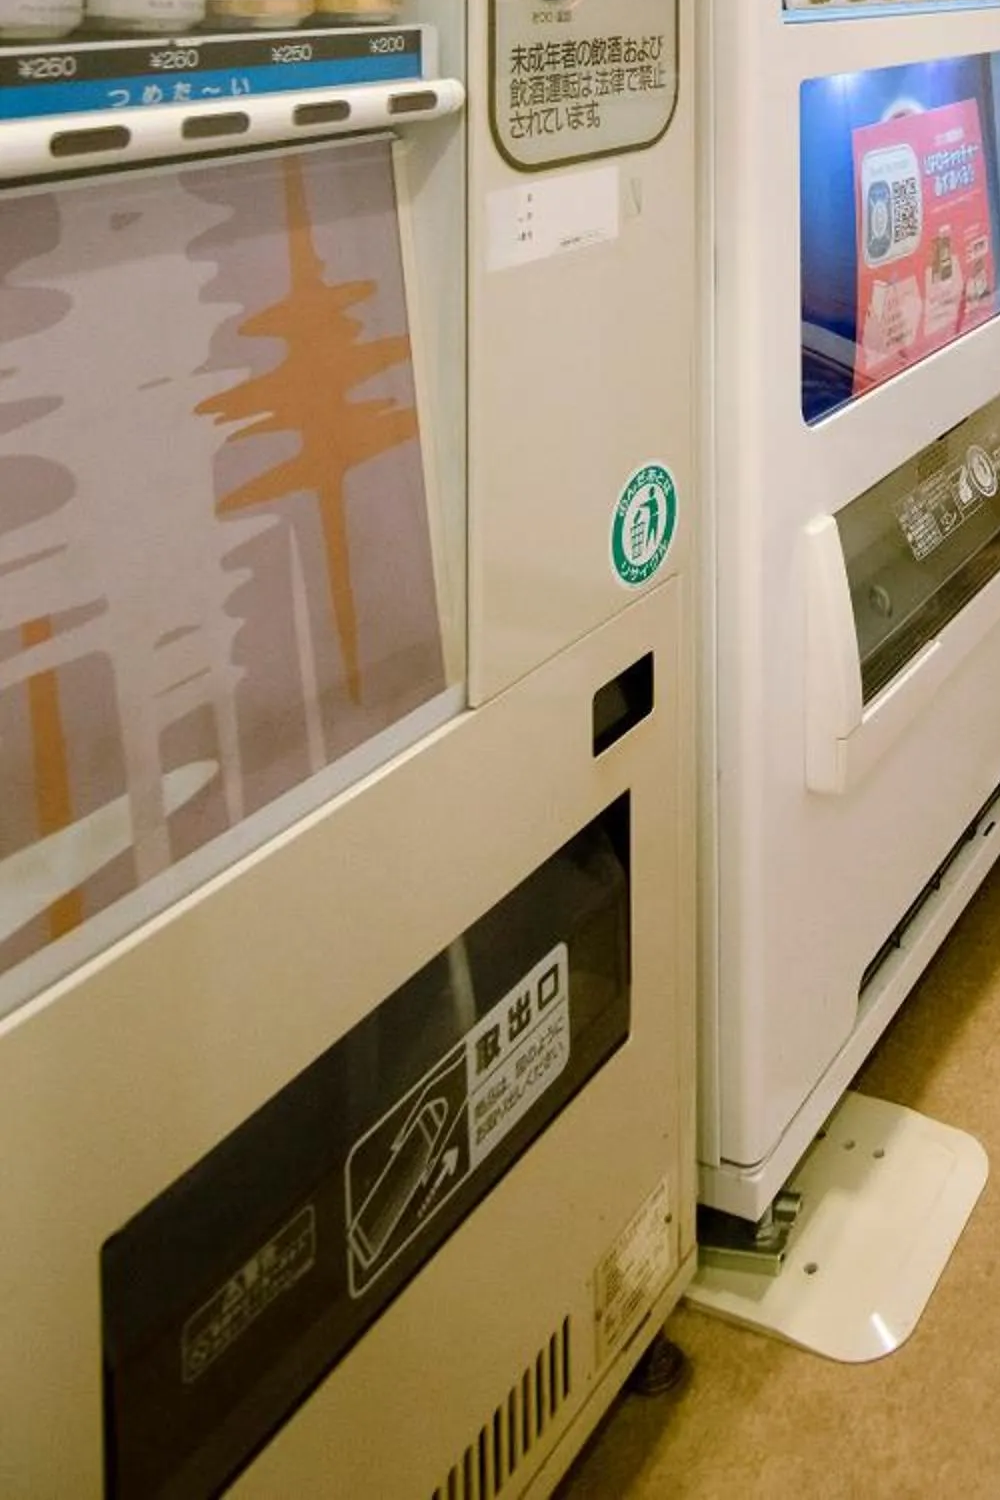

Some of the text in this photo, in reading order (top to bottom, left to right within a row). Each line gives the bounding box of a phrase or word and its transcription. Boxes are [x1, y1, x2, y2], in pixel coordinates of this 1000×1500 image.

[271, 43, 313, 64] ¥250
[369, 35, 405, 54] ¥200
[510, 34, 664, 75] 未成年者の飲酒および
[18, 55, 77, 79] ¥260
[150, 49, 200, 73] ¥260
[510, 61, 667, 109] 飲酒運転は法律で禁止
[475, 962, 559, 1077] 取出口
